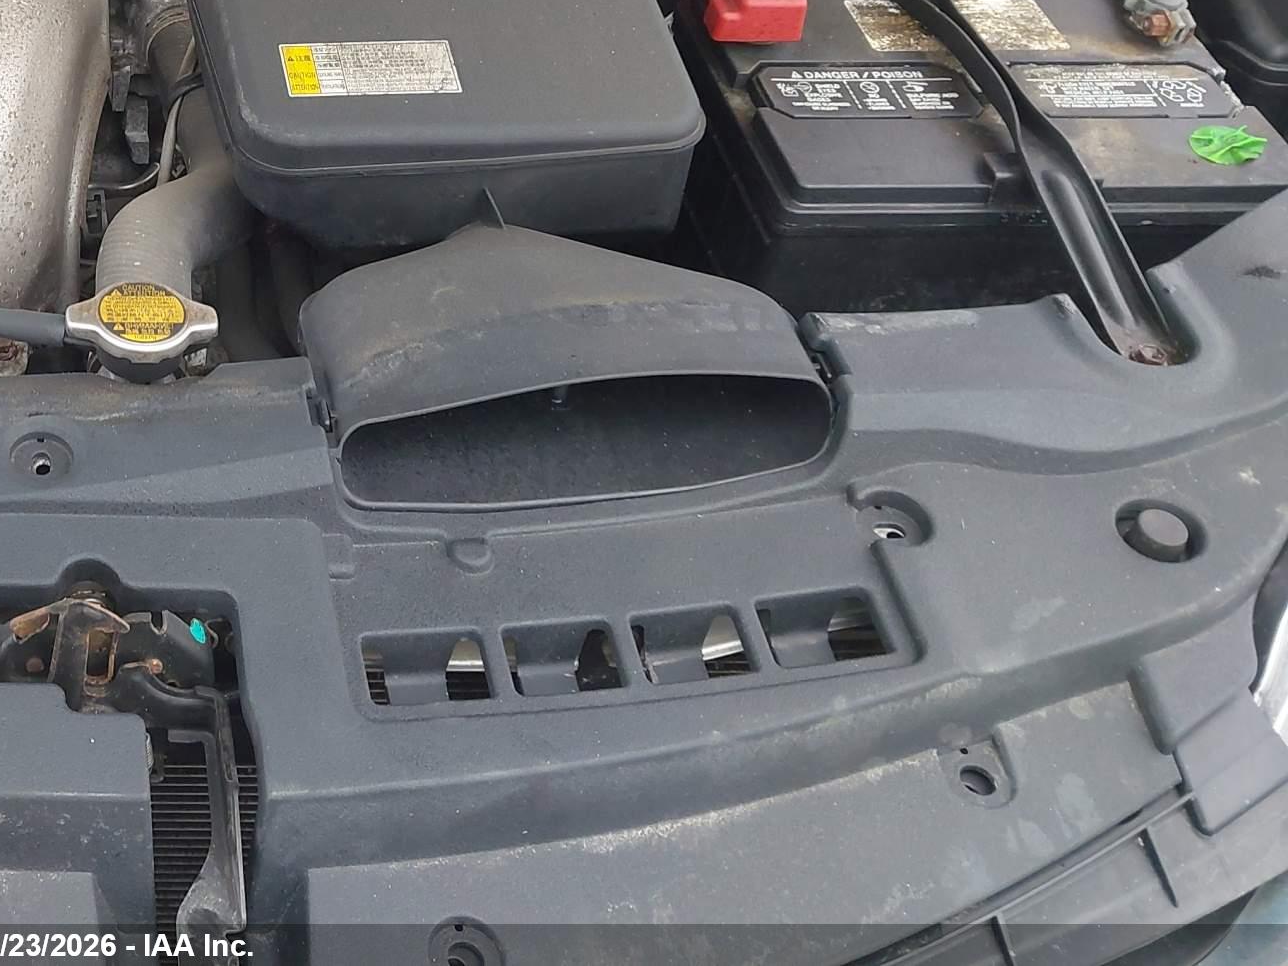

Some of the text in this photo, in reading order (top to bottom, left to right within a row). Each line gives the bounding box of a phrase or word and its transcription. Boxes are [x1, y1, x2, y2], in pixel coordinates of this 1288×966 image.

[803, 70, 924, 79] DANGER / POISON
